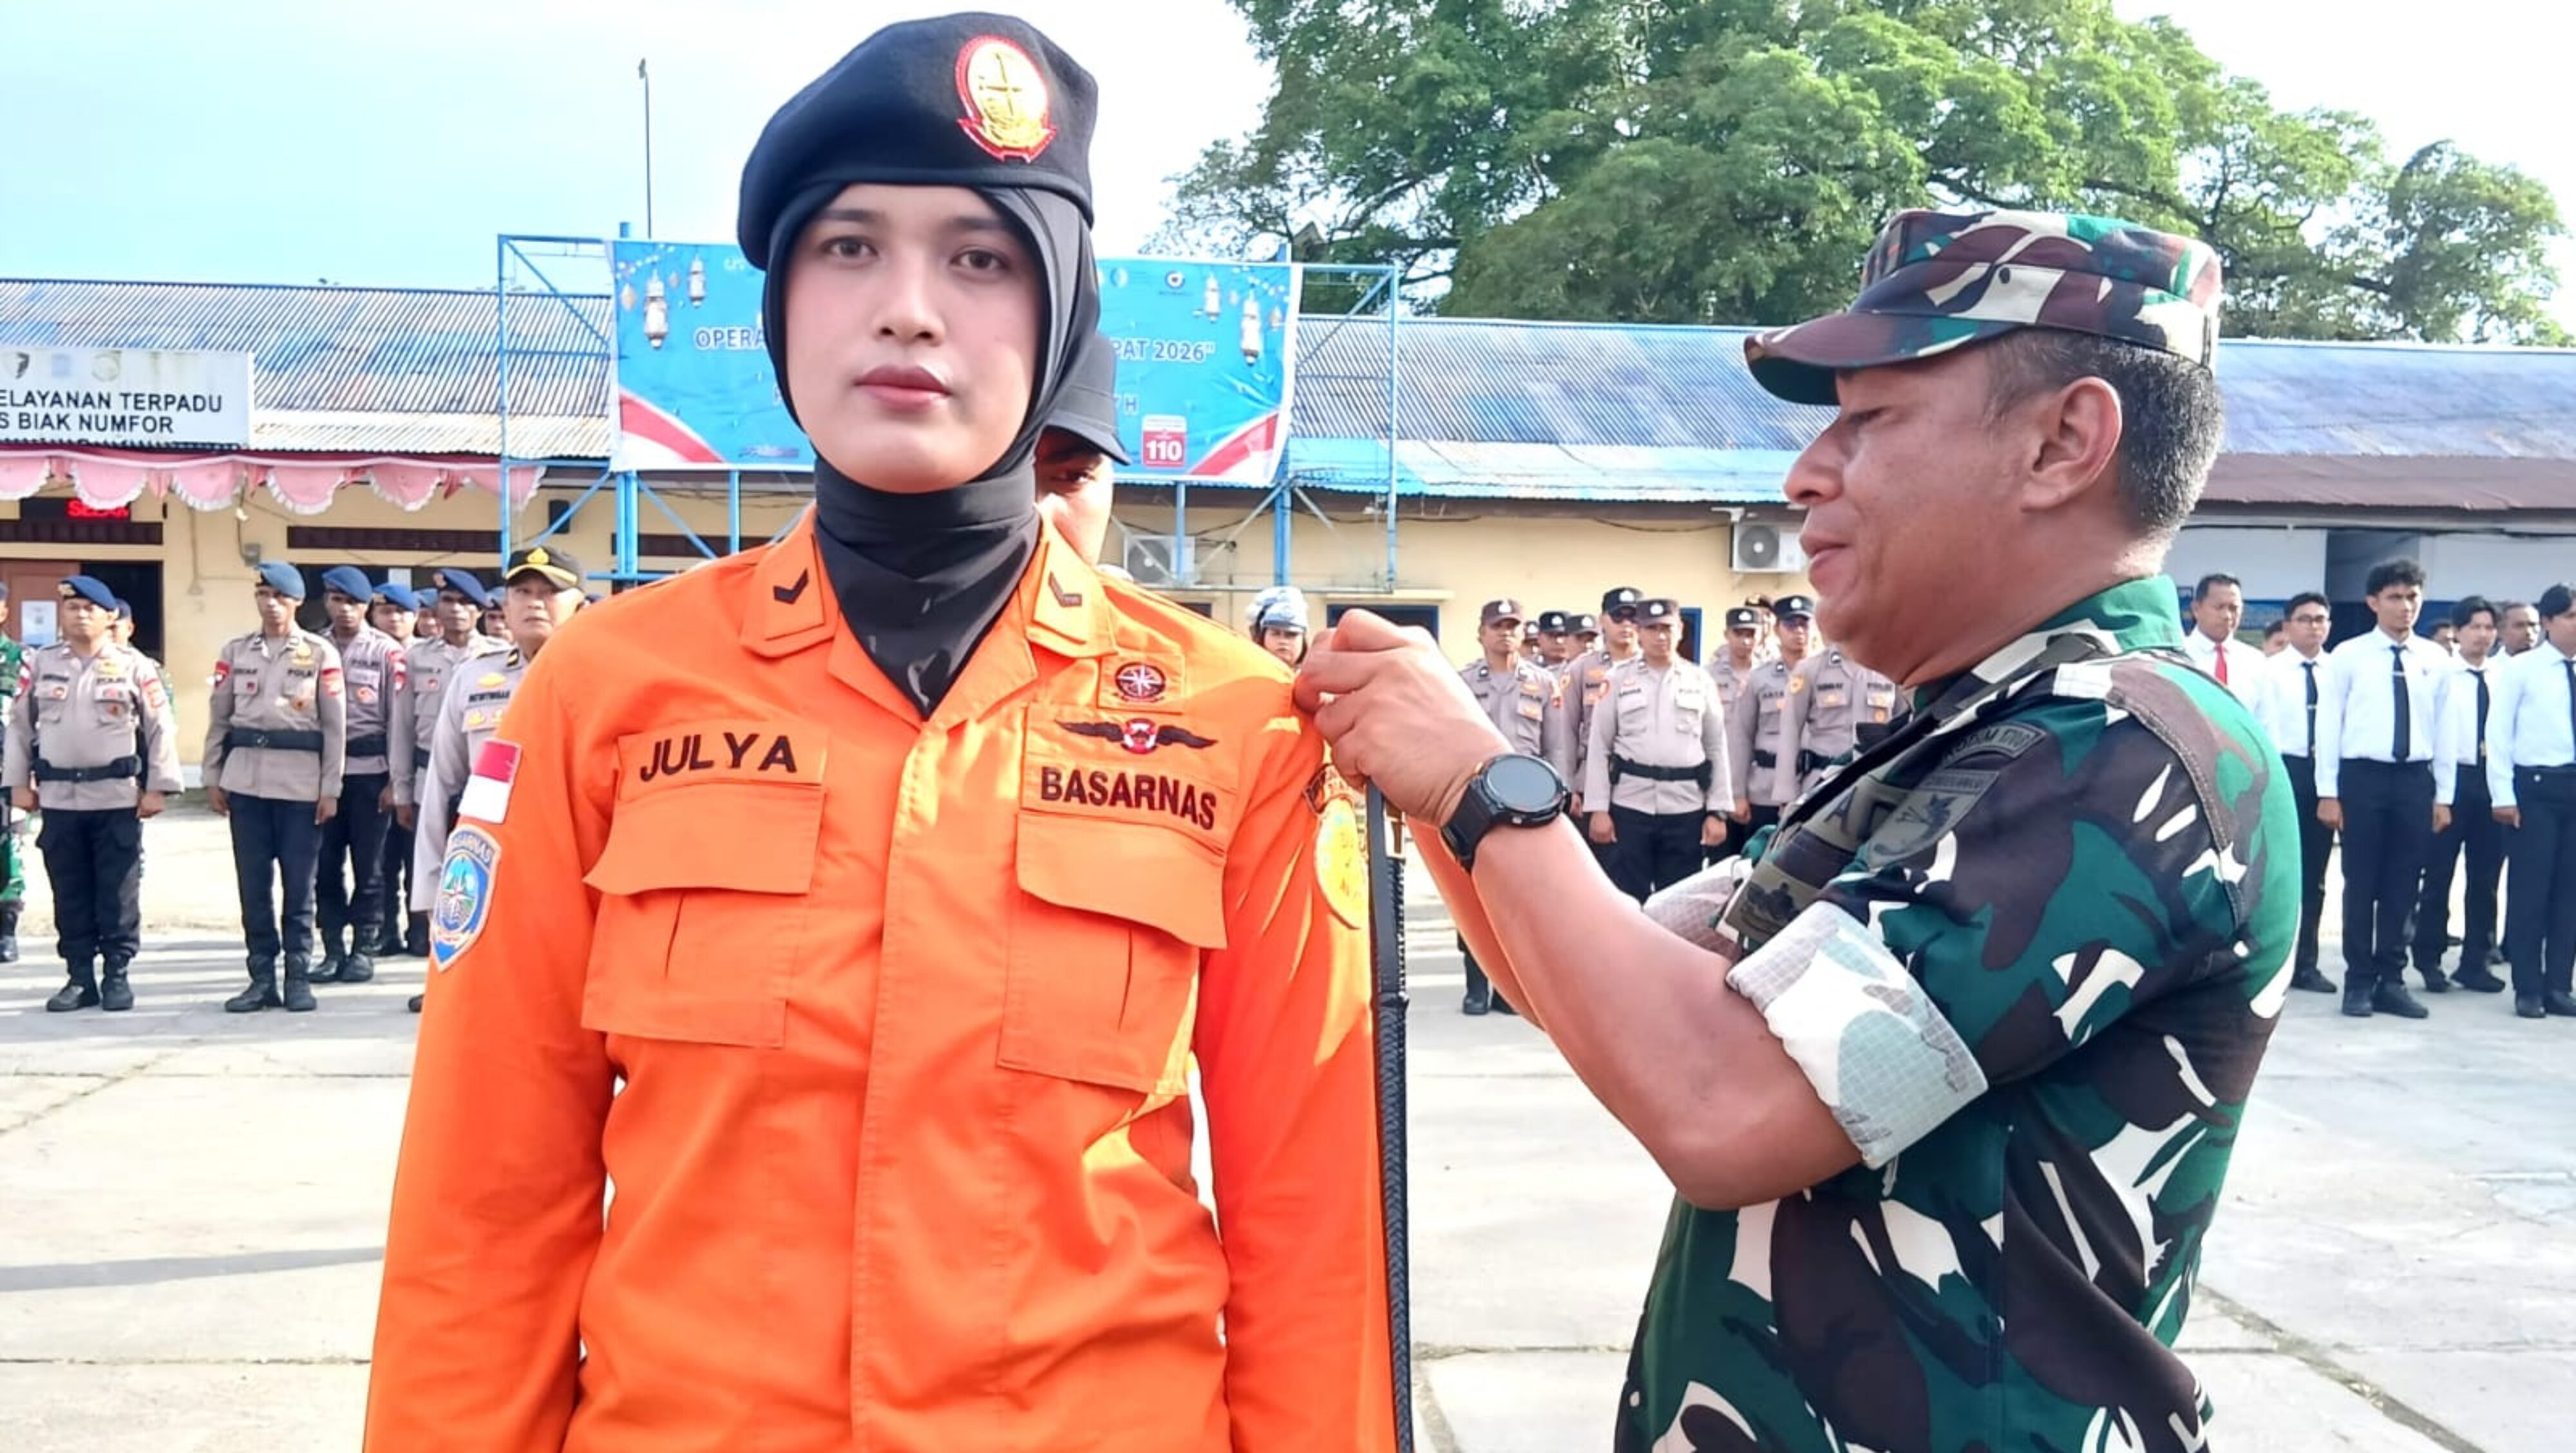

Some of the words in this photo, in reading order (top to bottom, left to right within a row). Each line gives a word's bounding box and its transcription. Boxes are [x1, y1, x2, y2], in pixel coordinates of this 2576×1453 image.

[0, 389, 111, 409] ELAYANAN
[119, 392, 222, 413] TERPADU
[18, 412, 71, 431] BIAK
[79, 413, 173, 433] NUMFOR
[1146, 440, 1182, 462] 110
[639, 732, 797, 782] JULYA
[1041, 766, 1217, 830] BASARNAS
